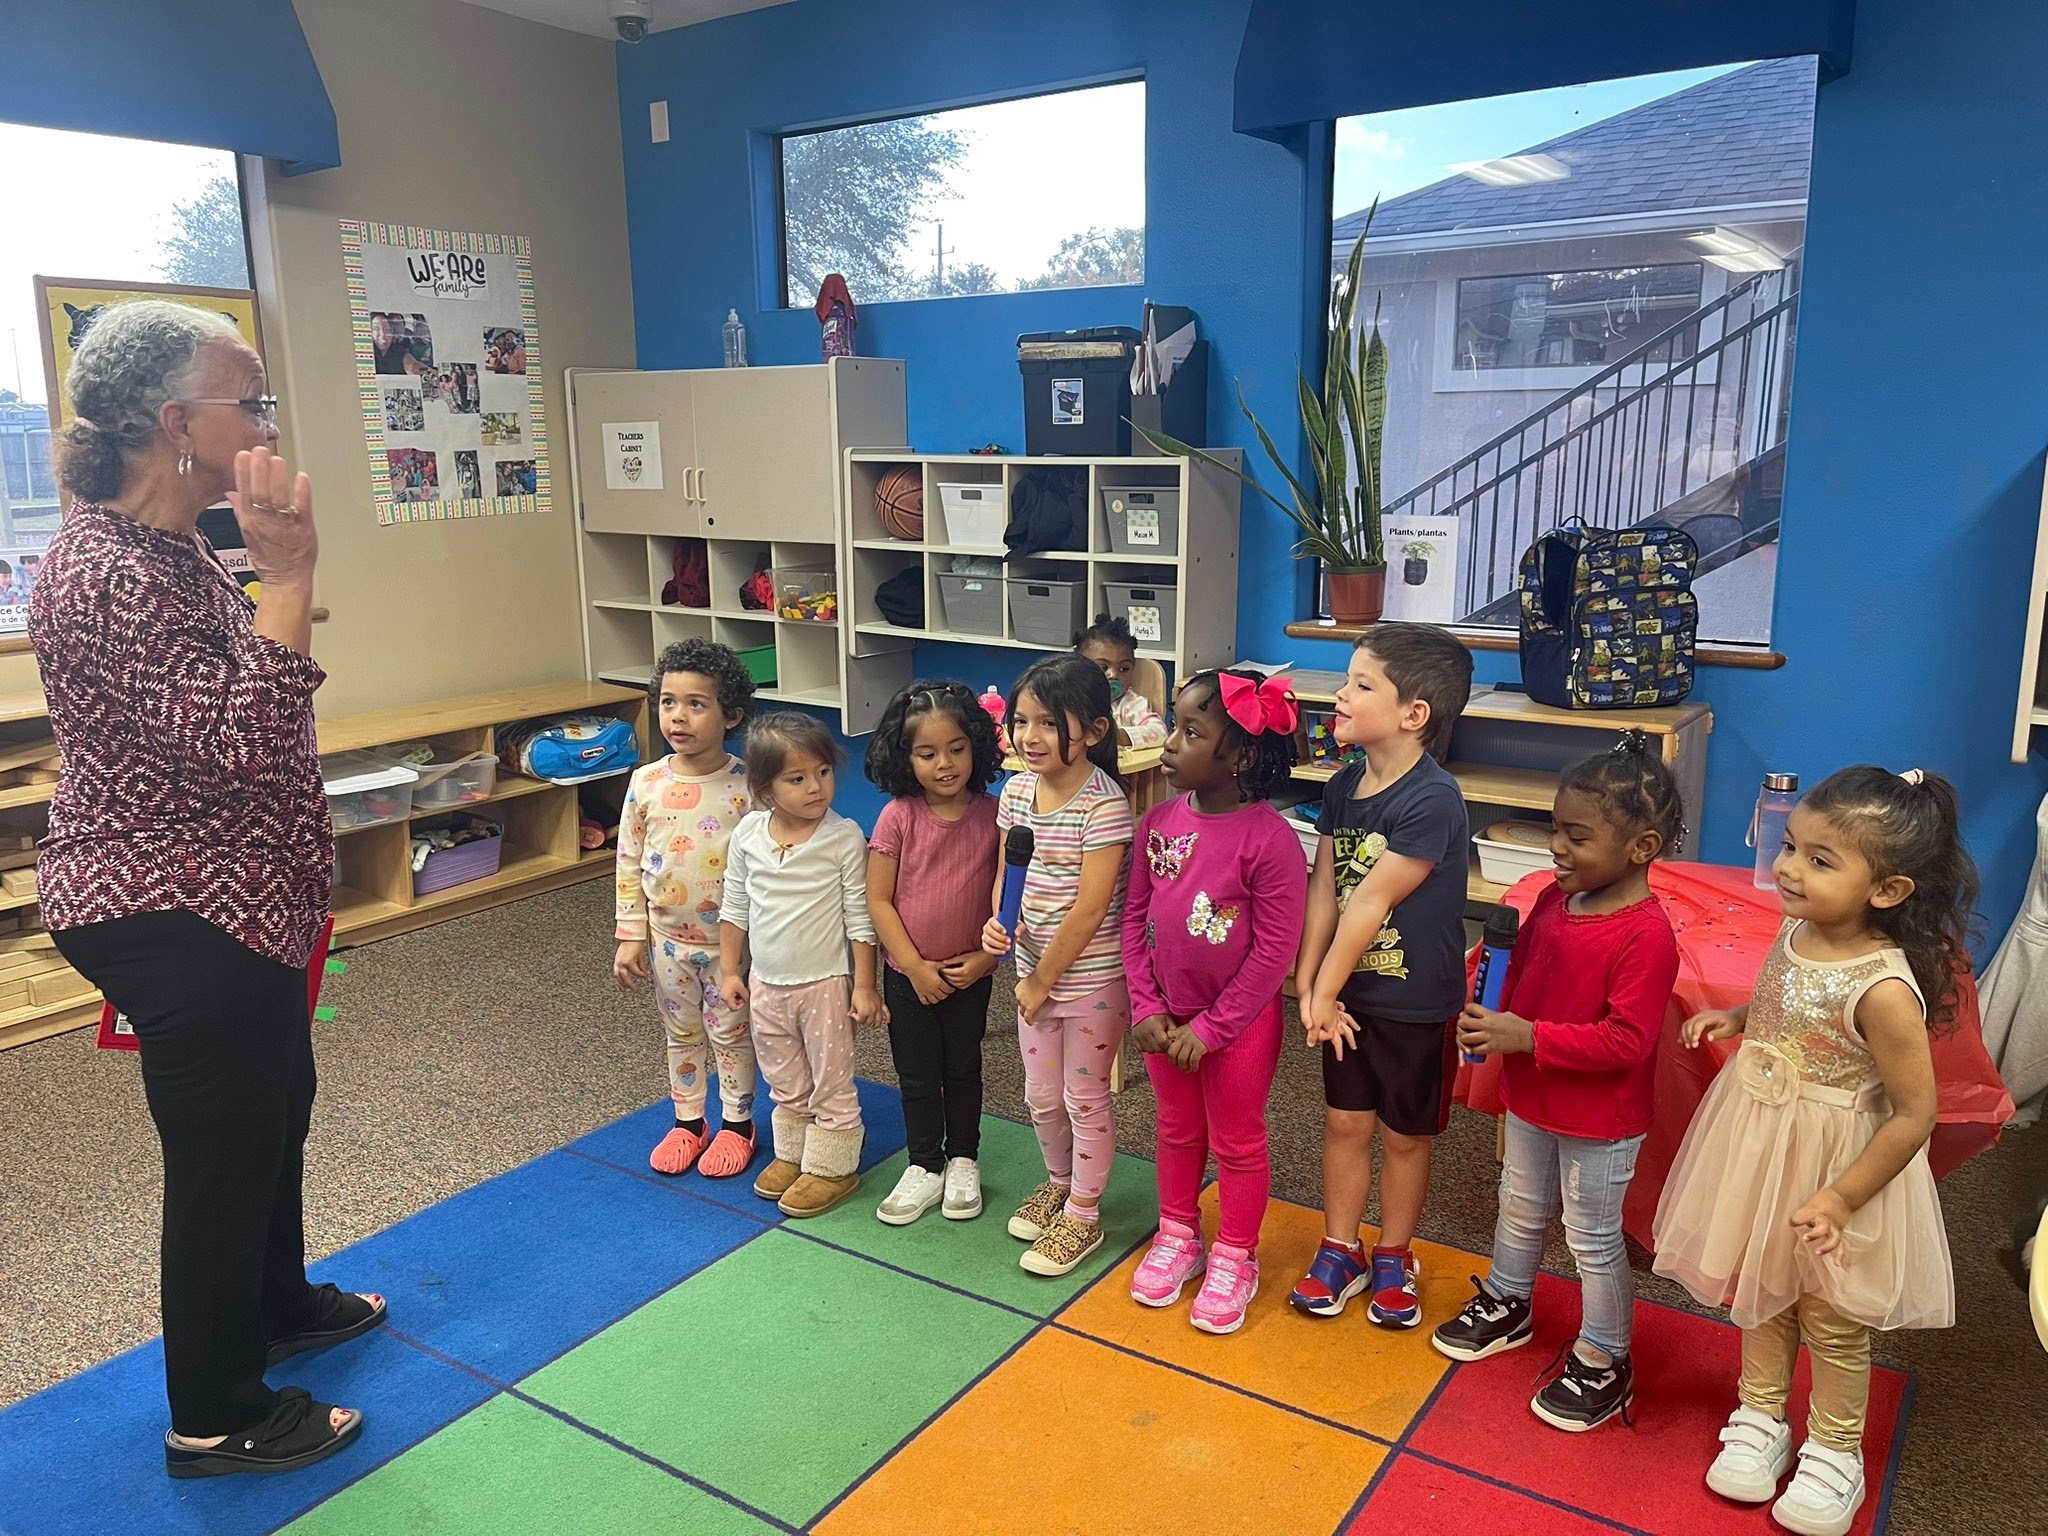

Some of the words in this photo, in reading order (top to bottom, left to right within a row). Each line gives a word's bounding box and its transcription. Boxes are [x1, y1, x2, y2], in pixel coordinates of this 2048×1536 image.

[407, 253, 444, 283] WE
[414, 278, 486, 298] family
[1389, 527, 1447, 538] Plants/plantas
